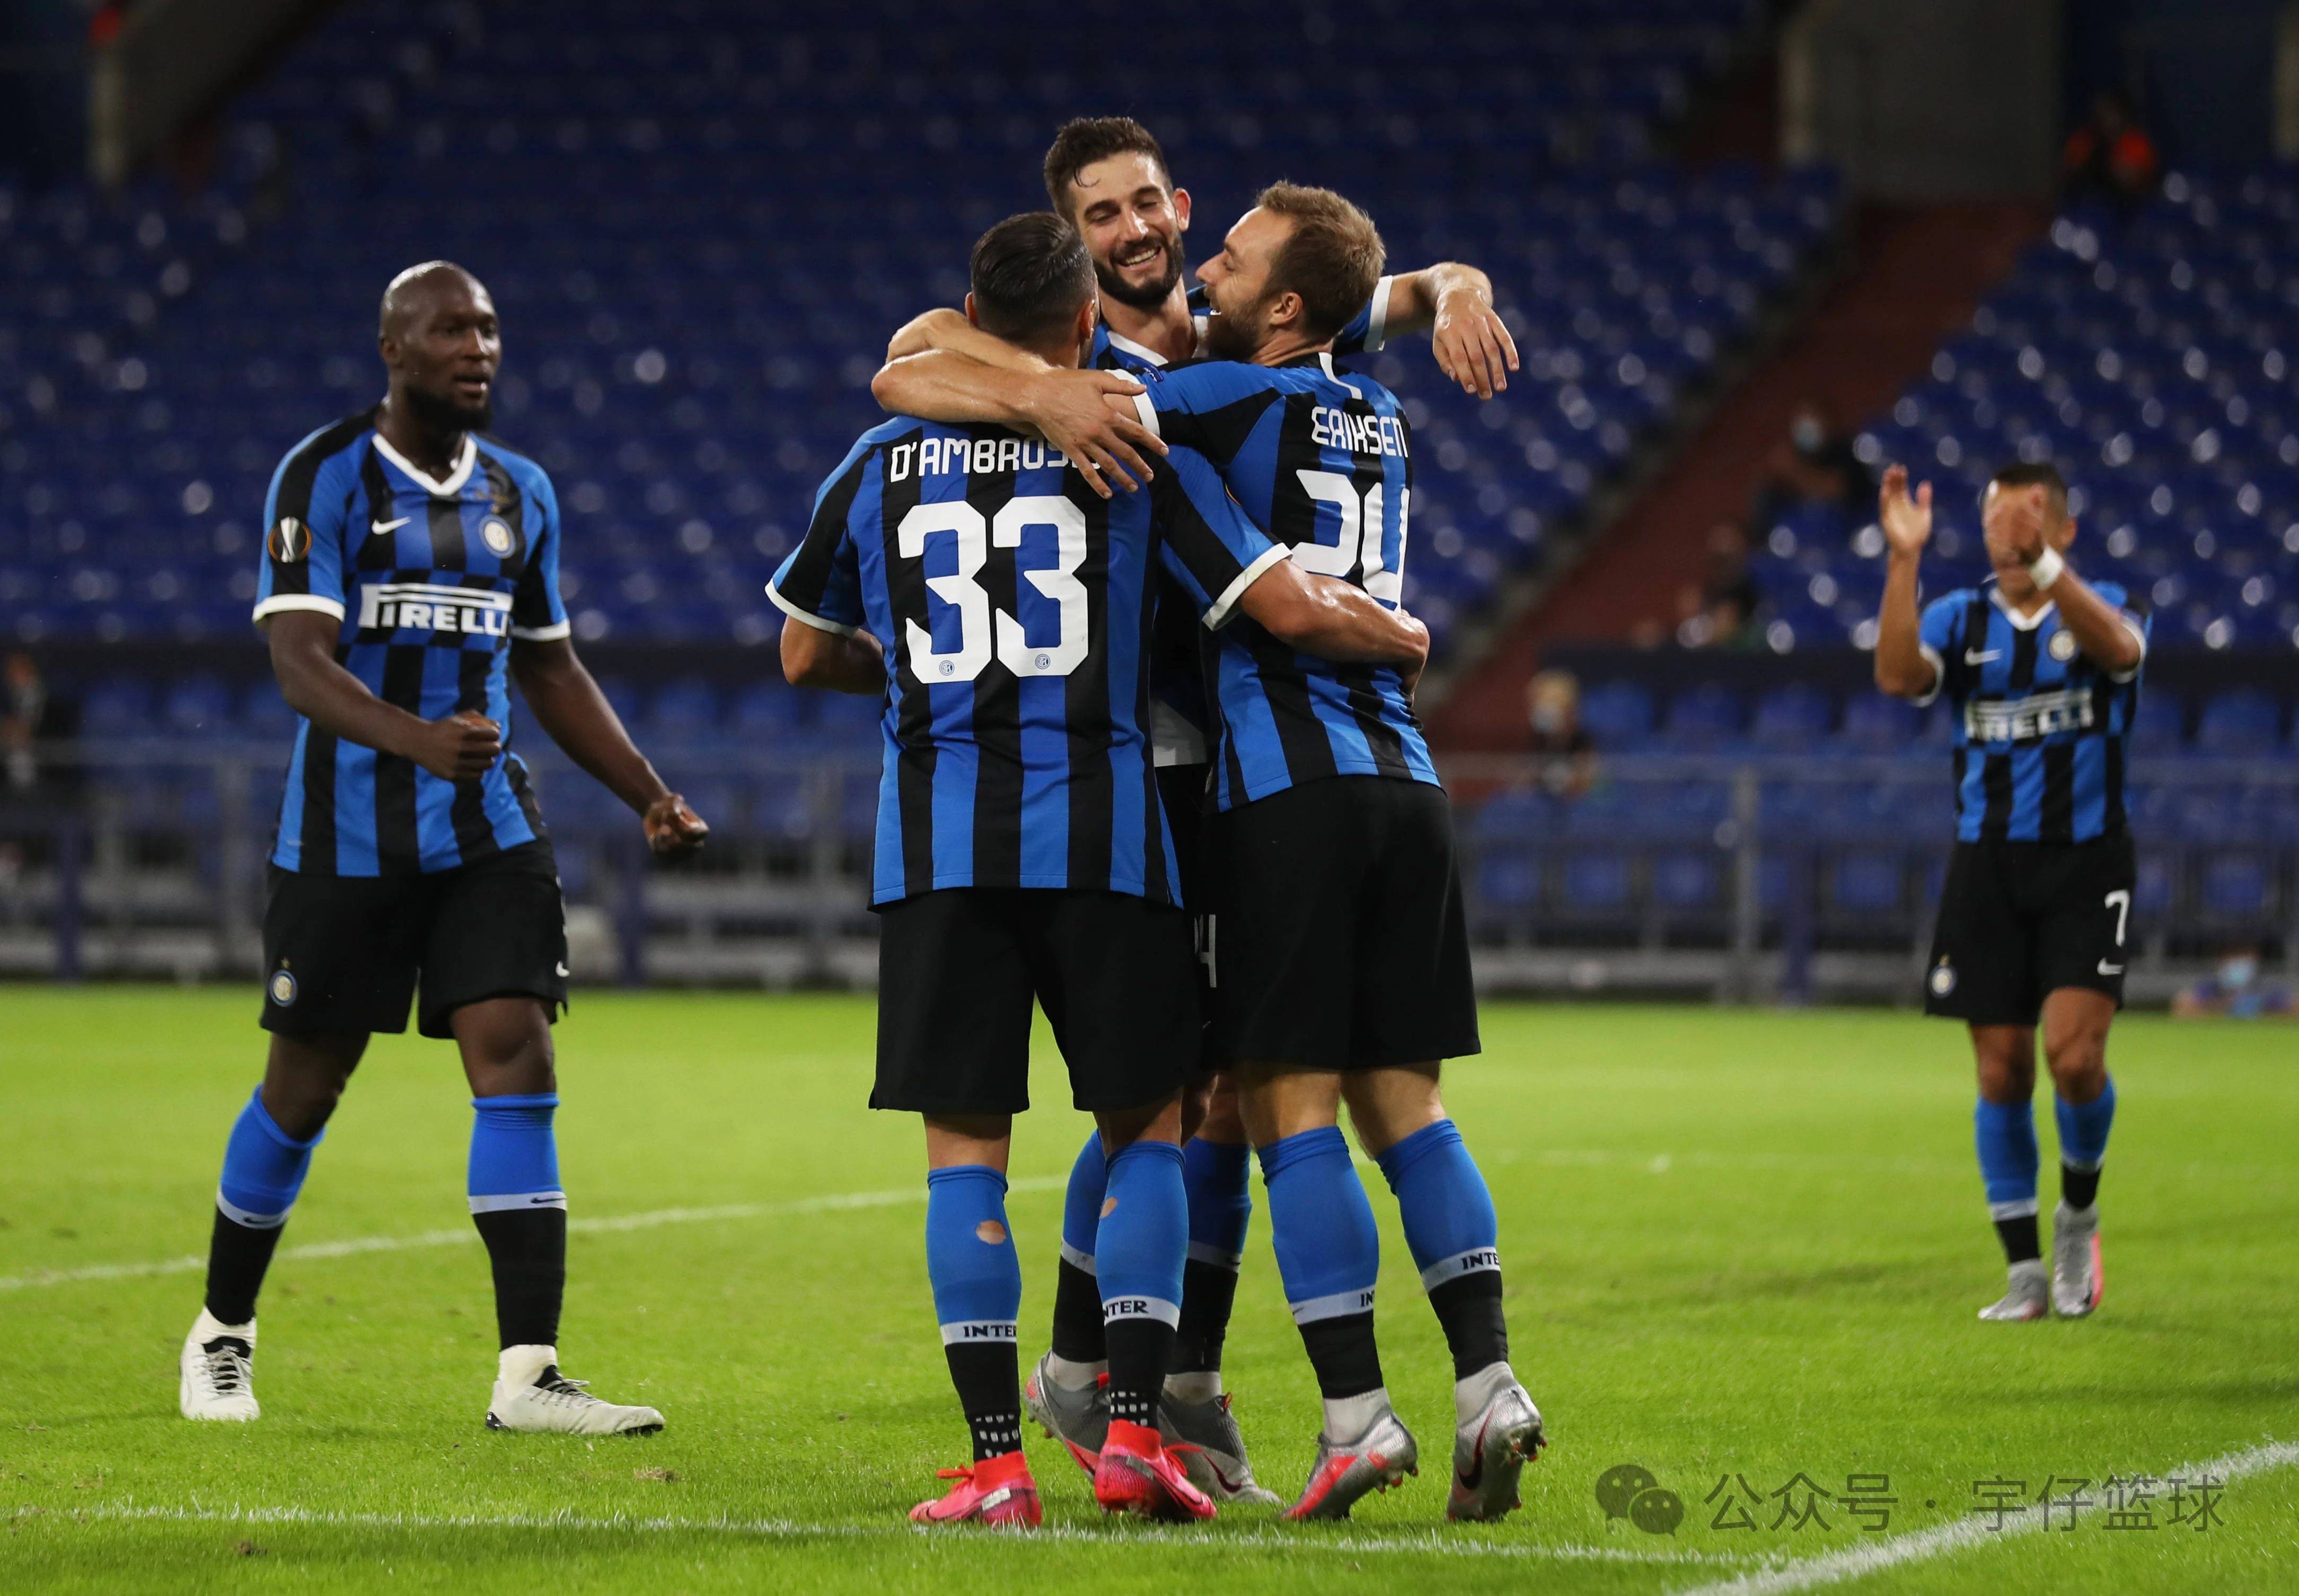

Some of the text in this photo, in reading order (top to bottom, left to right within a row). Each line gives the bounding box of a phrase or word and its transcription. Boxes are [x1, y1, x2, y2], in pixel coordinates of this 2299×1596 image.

[1311, 405, 1408, 458] ERIKSEN
[891, 438, 1102, 483] D'AMBROS
[897, 496, 1089, 684] 33
[2104, 889, 2130, 947] 7
[1194, 914, 1217, 988] 4
[1461, 1252, 1500, 1269] INTE
[1103, 1300, 1149, 1318] NTER
